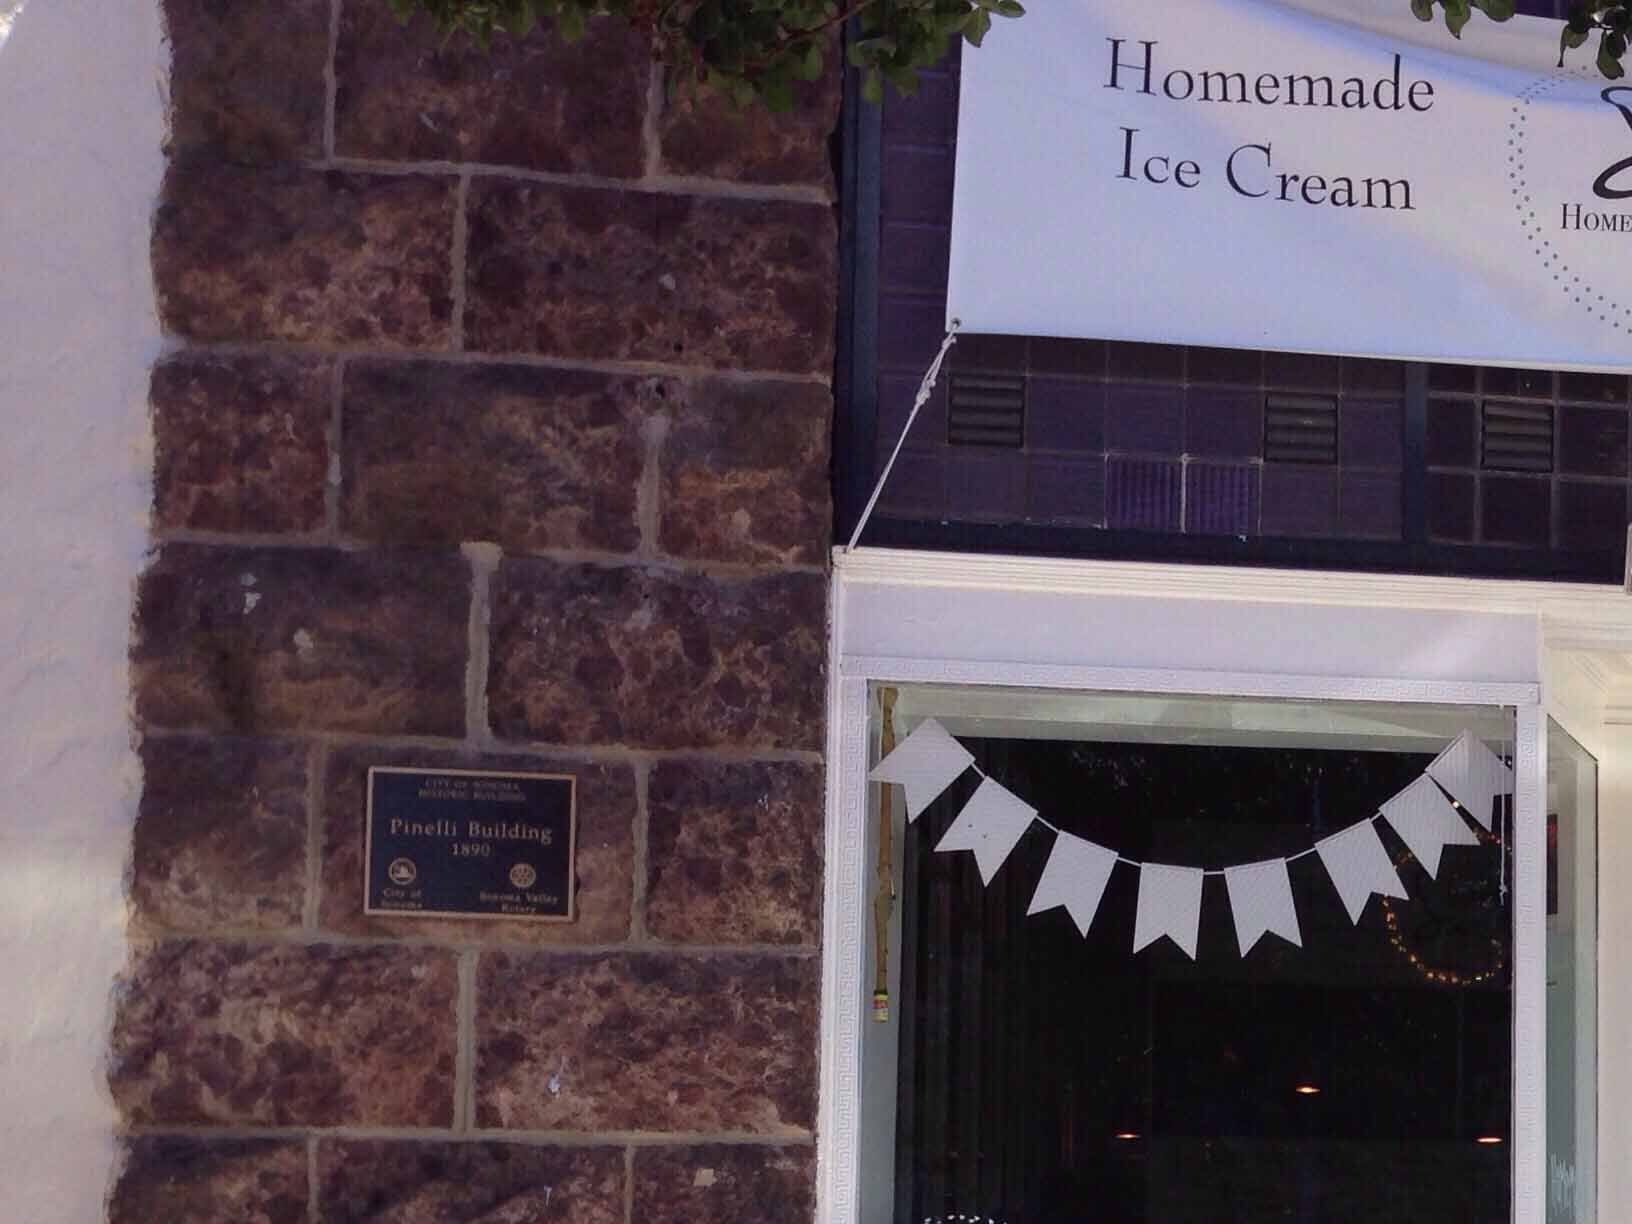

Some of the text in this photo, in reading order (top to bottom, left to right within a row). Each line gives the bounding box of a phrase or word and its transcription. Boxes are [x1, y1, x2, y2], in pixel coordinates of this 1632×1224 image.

[1103, 37, 1437, 113] Homemade
[1115, 127, 1417, 211] Ice Cream
[390, 818, 554, 846] Pinelli Building
